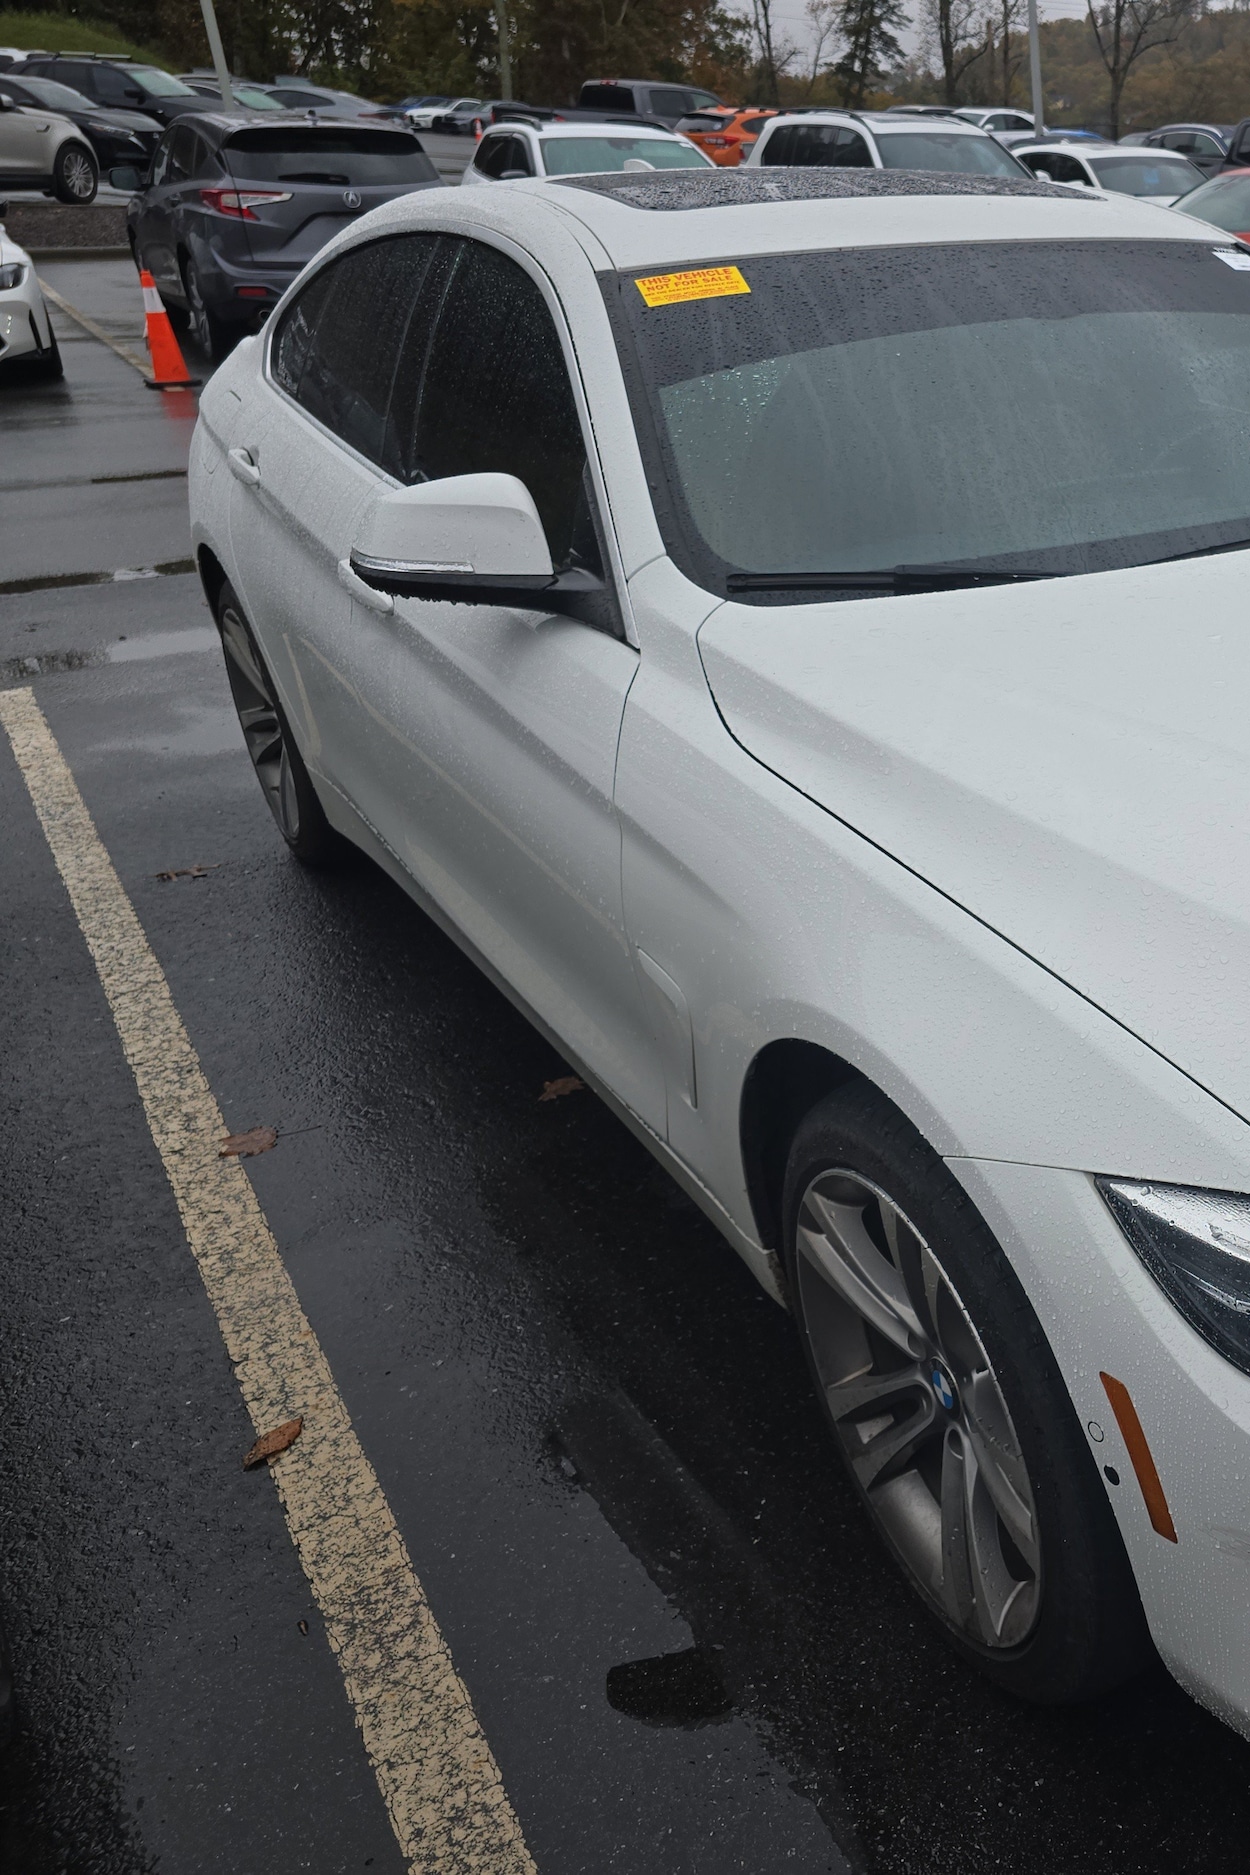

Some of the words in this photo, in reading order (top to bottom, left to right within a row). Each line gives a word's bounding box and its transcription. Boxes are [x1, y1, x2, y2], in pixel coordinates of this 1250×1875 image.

[641, 276, 671, 286] THIS
[674, 268, 732, 280] VEHICLE
[646, 283, 670, 292] NOT
[674, 279, 699, 288] FOR
[702, 275, 733, 283] SALE
